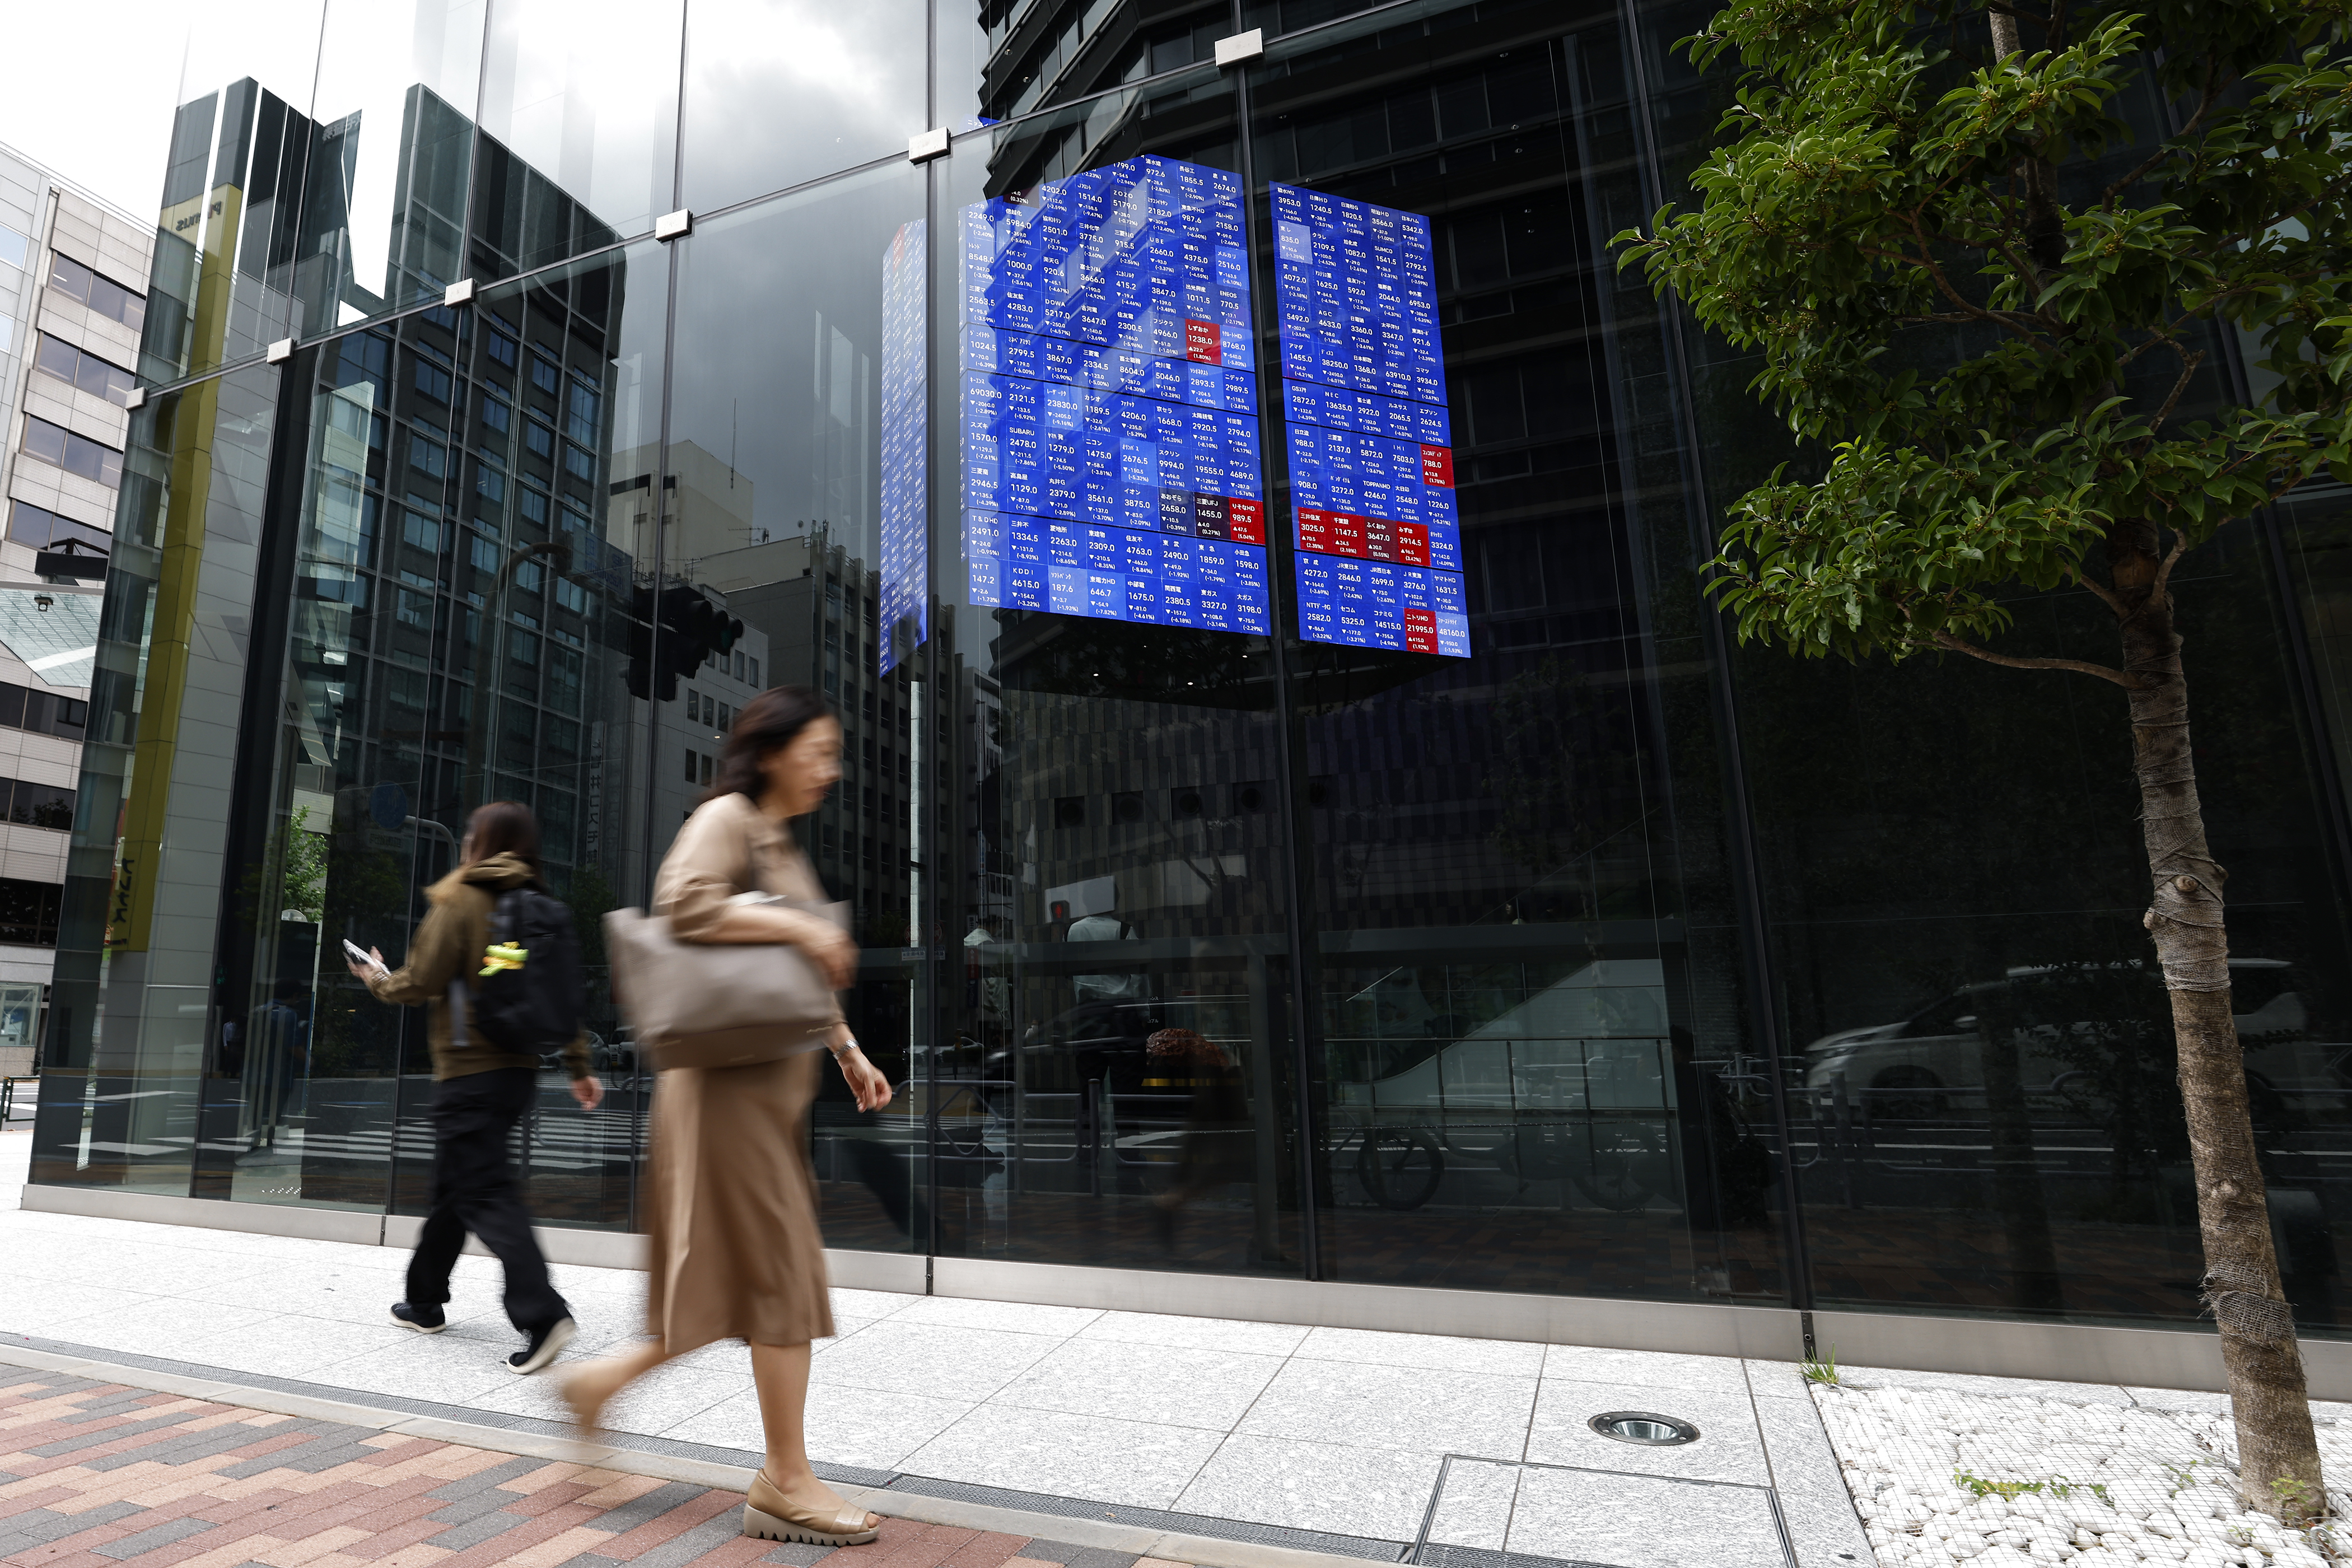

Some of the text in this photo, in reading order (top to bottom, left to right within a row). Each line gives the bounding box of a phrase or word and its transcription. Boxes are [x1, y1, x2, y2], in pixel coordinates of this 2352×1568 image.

[1146, 168, 1165, 178] 972.6
[1180, 175, 1203, 186] 1855.5
[1041, 185, 1067, 195] 4202.0
[1214, 182, 1236, 193] 2674.0
[1078, 192, 1102, 203] 1514.0
[1185, 193, 1205, 202] (-2.90%)
[1278, 197, 1301, 207] 3953.0
[1047, 203, 1067, 212] (-2.59%)
[1113, 199, 1137, 211] 5179.0
[968, 211, 994, 222] 2249.0
[1182, 214, 1202, 223] 987.6
[1215, 211, 1234, 220] 7&I-HD
[1341, 211, 1362, 221] 1820.5
[1006, 218, 1032, 229] 5984.0
[1216, 221, 1239, 231] 2158.0
[1315, 221, 1333, 229] (-3.01%)
[1043, 225, 1068, 236] 2501.0
[1153, 225, 1175, 234] (-12.40%)
[1402, 225, 1424, 235] 5342.0
[1313, 241, 1335, 252] 2109.5
[1374, 245, 1393, 254] SUMCO
[968, 253, 995, 264] 8548.0
[1184, 254, 1208, 264] 4375.0
[1375, 255, 1397, 265] 1541.5
[1006, 259, 1032, 271] 1000.0
[1218, 260, 1241, 271] 2516.0
[1350, 265, 1368, 274] (-2.61%)
[1116, 281, 1136, 291] 415.2
[1223, 278, 1242, 287] (-6.10%)
[1220, 290, 1237, 298] ENEOS
[1347, 286, 1365, 296] 592.0
[969, 295, 995, 306] 2563.5
[1045, 298, 1066, 307] DOWA
[1186, 293, 1210, 304] 1011.5
[1220, 300, 1239, 310] 770.5
[1188, 334, 1212, 345] 1238.0
[1412, 337, 1431, 347] 921.6
[1322, 358, 1348, 370] 38250.0
[1119, 366, 1145, 376] 8604.0
[970, 388, 1002, 399] 69030.0
[1009, 393, 1035, 404] 2121.5
[1085, 405, 1110, 416] 1189.5
[1230, 403, 1249, 412] (-3.81%)
[1014, 413, 1036, 422] (-5.92%)
[1121, 410, 1146, 421] 4206.0
[1009, 427, 1035, 436] SUBARU
[1192, 422, 1217, 432] 2920.5
[971, 432, 997, 443] 1570.0
[1295, 438, 1314, 448] 988.0
[1086, 449, 1112, 460] 1475.0
[1123, 454, 1148, 465] 2676.5
[1159, 460, 1184, 470] 9994.0
[1423, 459, 1442, 468] 788.0
[1194, 465, 1224, 476] 19555.0
[1011, 483, 1038, 494] 1129.0
[1200, 484, 1220, 493] (-6.16%)
[1362, 480, 1390, 489] TOPPANHD
[1049, 488, 1076, 499] 2379.0
[1364, 491, 1387, 500] 4246.0
[1197, 509, 1222, 519] 1455.0
[1232, 514, 1252, 523] 989.5
[972, 526, 999, 537] 2491.0
[1301, 523, 1324, 533] 3025.0
[1367, 532, 1390, 542] 3647.0
[1126, 546, 1152, 556] 4763.0
[1163, 550, 1189, 561] 2490.0
[972, 574, 995, 584] 147.2
[1012, 579, 1040, 589] 4615.0
[1371, 577, 1394, 586] 2699.0
[1052, 583, 1074, 593] 187.6
[1435, 585, 1457, 595] 1631.5
[1128, 592, 1154, 602] 1675.0
[1057, 604, 1079, 613] (-1.93%)
[1237, 604, 1262, 614] 3198.0
[1243, 624, 1263, 633] (-2.29%)
[1374, 620, 1402, 630] 14515.0
[1407, 624, 1434, 634] 21995.0
